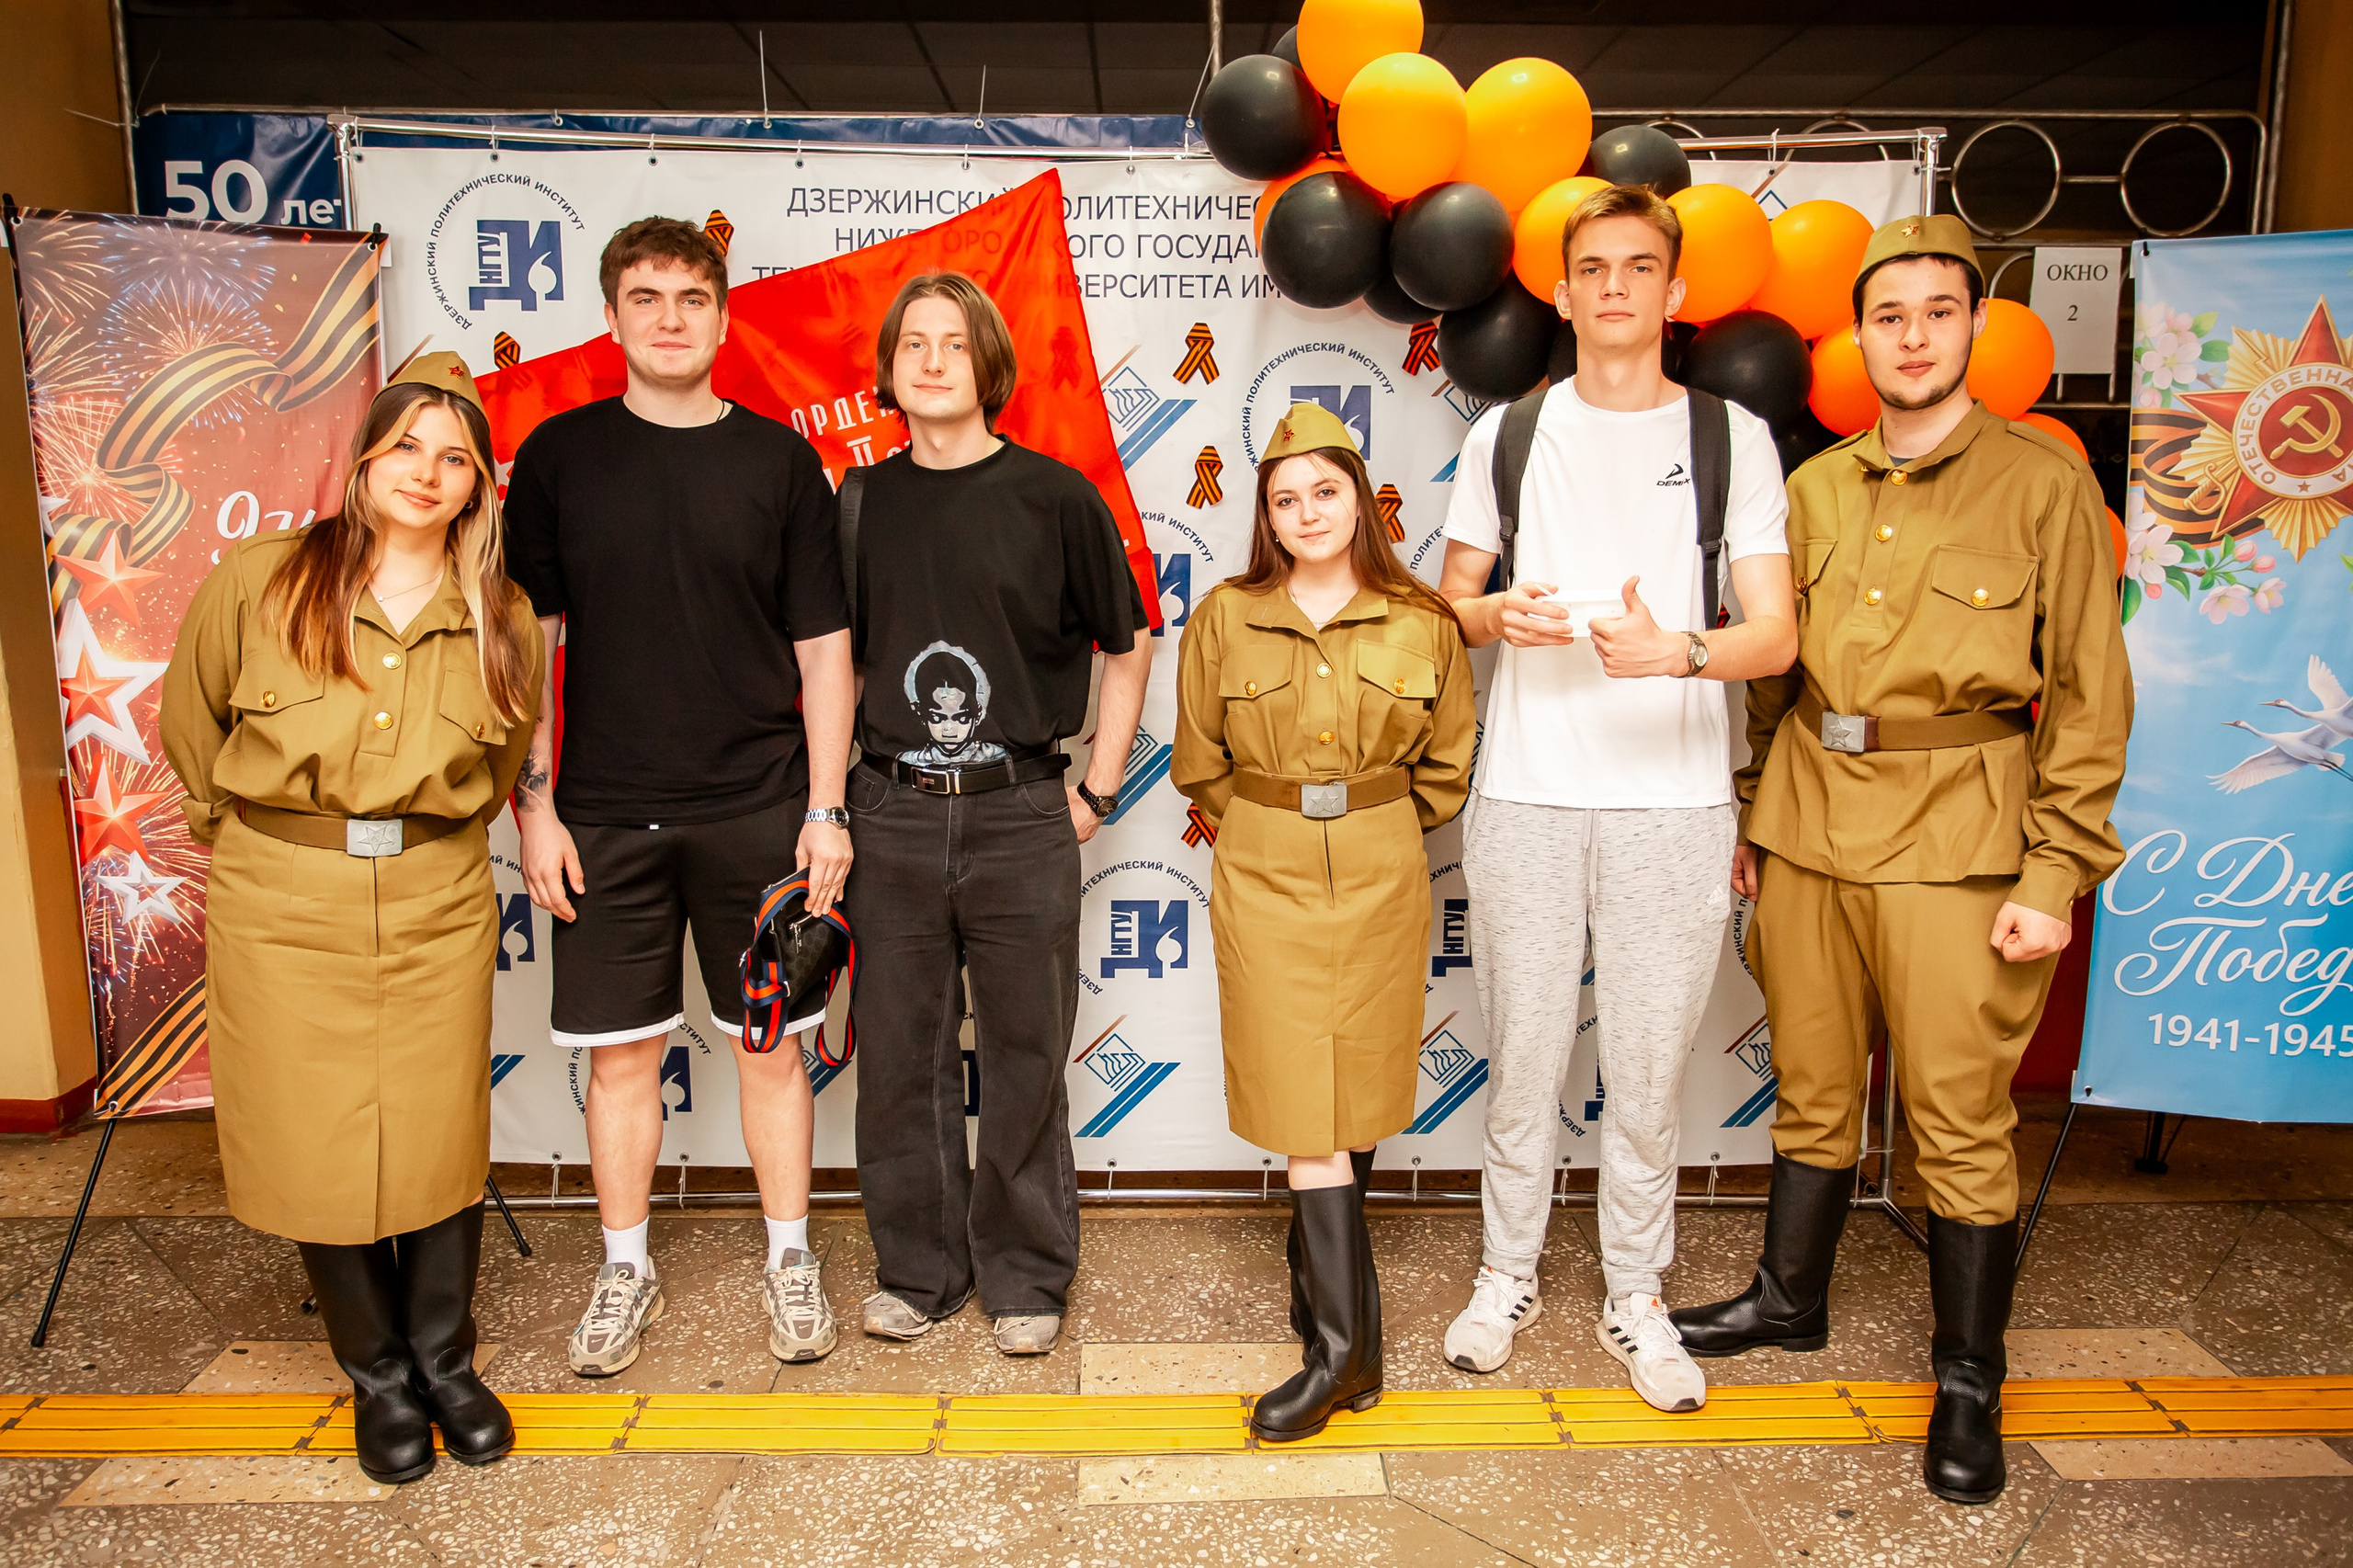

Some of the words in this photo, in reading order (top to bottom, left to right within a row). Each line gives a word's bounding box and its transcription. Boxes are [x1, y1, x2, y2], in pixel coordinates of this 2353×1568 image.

[165, 159, 268, 223] 50
[430, 173, 531, 238] ПОЛИТЕХНИЧЕСКИЙ
[534, 181, 585, 232] ИНСТИТУТ
[787, 187, 1014, 217] ДЗЕРЖИНСК
[1062, 195, 1262, 221] ОЛИТЕХНИЧЕ
[1137, 233, 1259, 265] ГОСУДА
[2046, 264, 2109, 281] ОКНО
[426, 241, 473, 331] ДЗЕРЖИНСКИЙ
[1075, 273, 1233, 300] ЕРСИТЕТА
[2067, 304, 2079, 322] 2
[1246, 342, 1346, 403] ПОЛИТЕХНИЧЕСКИЙ
[1347, 348, 1395, 395] ИНСТИТУТ
[2239, 368, 2353, 485] ОТЕЧЕСТВЕННА
[1168, 517, 1214, 562] ИНСТИТУТ
[1081, 860, 1164, 898] ИТЕХНИЧЕСКИЙ
[1166, 867, 1210, 908] ИНСТИТУТ
[2102, 829, 2188, 916] С
[2194, 833, 2353, 908] Дне
[2114, 914, 2353, 1017] Побед
[678, 1022, 711, 1056] СТИТУТ
[2147, 1013, 2353, 1058] 1941-1945
